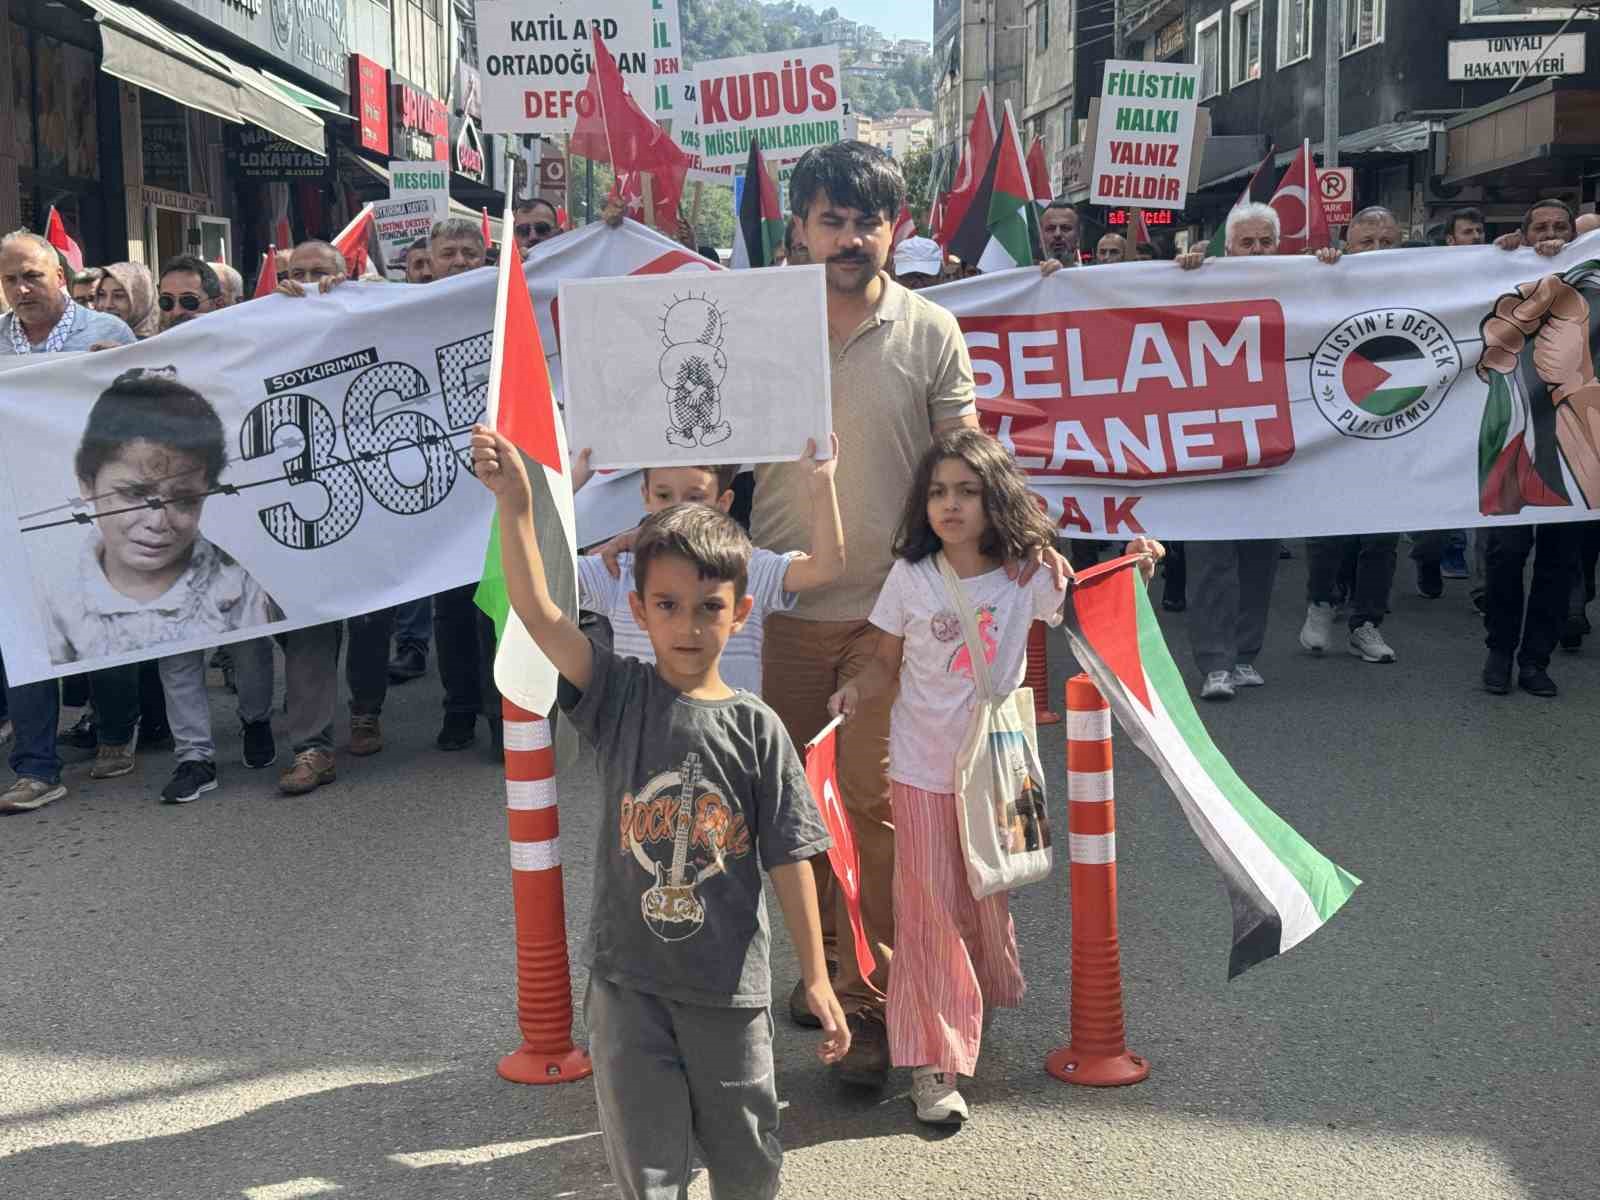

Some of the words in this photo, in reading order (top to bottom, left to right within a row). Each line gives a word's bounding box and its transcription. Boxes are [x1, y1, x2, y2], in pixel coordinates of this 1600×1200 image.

[510, 14, 567, 41] KATİL
[1464, 60, 1529, 77] HAKAN'IN
[1534, 53, 1564, 73] YERİ
[700, 58, 837, 125] KUDÜS
[1107, 69, 1196, 99] FİLİSTİN
[524, 89, 597, 119] DEFO
[1115, 107, 1179, 133] HALKI
[1110, 141, 1179, 167] YALNIZ
[393, 170, 445, 189] MESCİDİ
[1098, 172, 1181, 201] DEİLDİR
[966, 315, 1263, 399] SELAM
[1316, 312, 1395, 377] FİLİSTİN'E
[1401, 314, 1455, 369] DESTEK
[271, 351, 372, 389] SOYKIRIMIN
[1040, 494, 1147, 534] AK
[620, 792, 681, 850] ROCK
